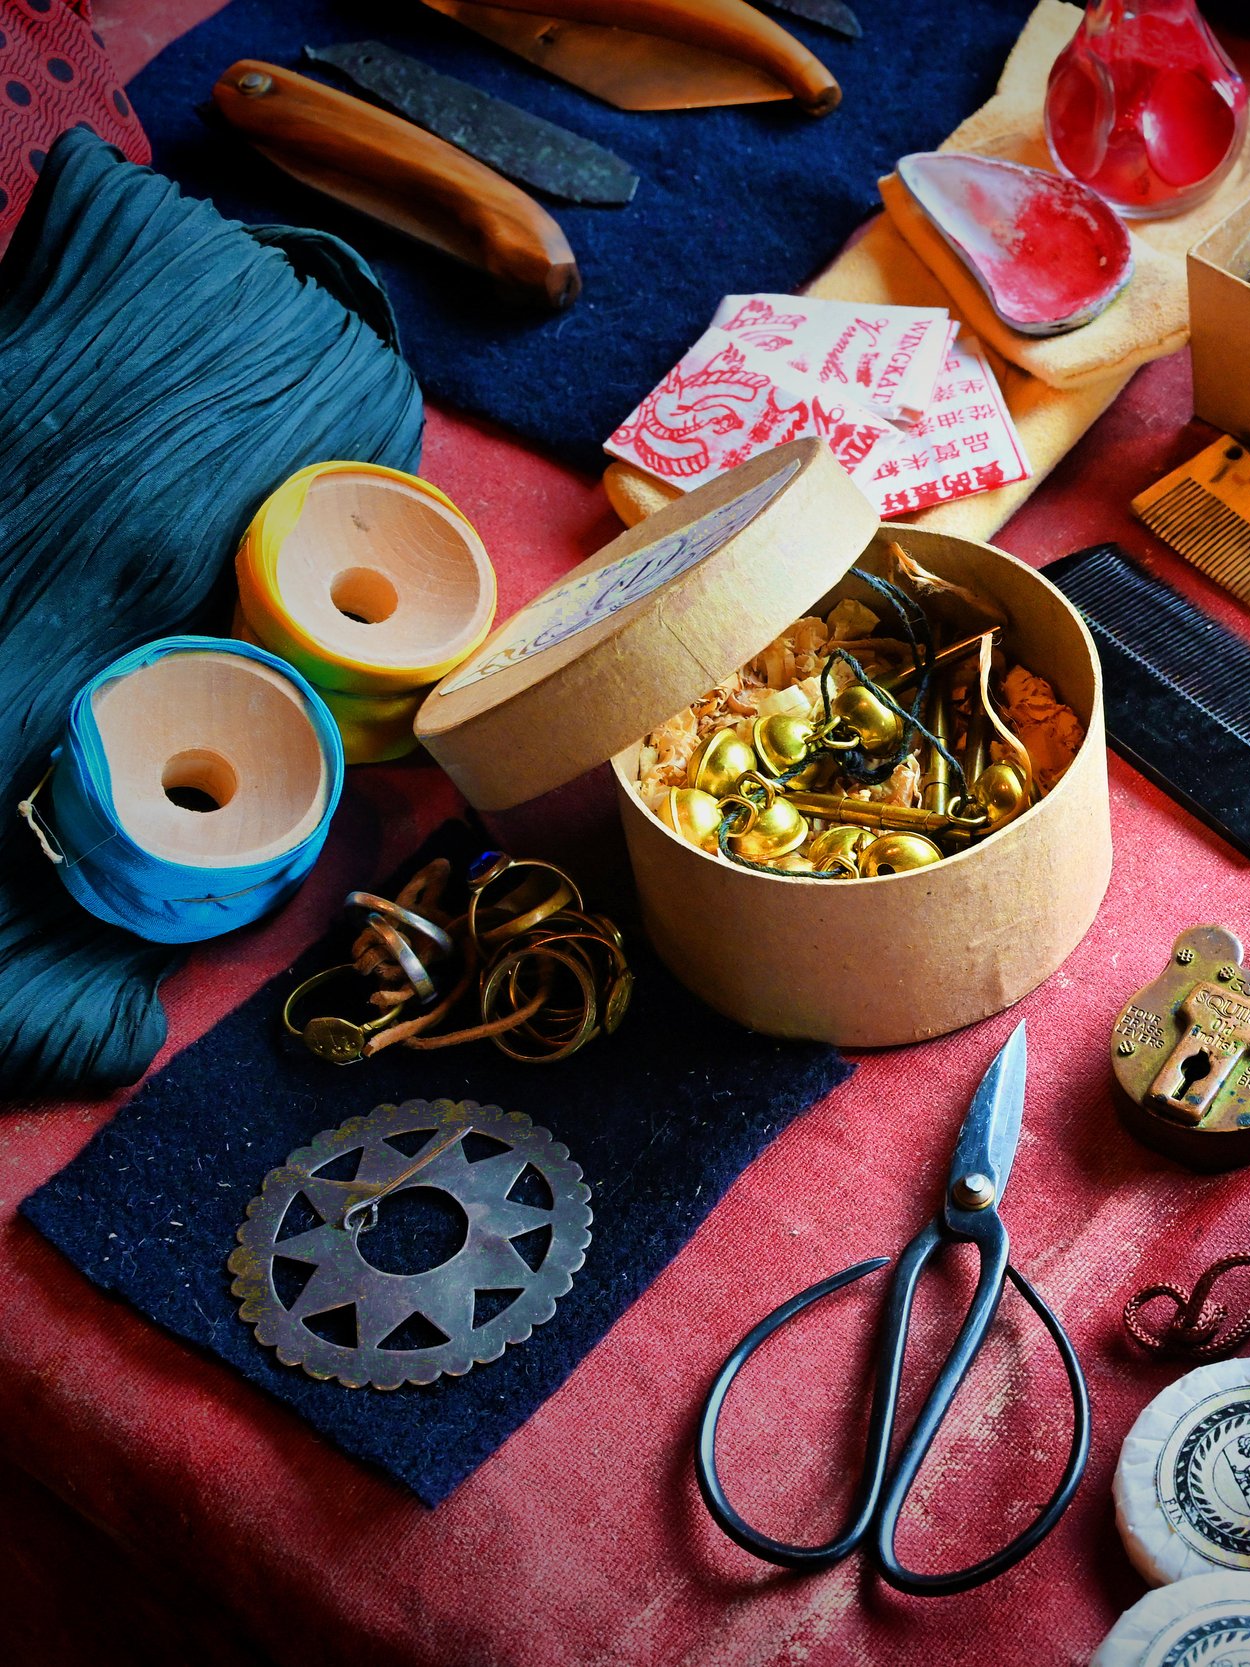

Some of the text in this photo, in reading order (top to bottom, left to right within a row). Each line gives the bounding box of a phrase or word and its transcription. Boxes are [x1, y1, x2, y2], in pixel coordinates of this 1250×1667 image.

[873, 319, 933, 404] WINGKAT
[905, 403, 997, 438] 從油漆
[1121, 1014, 1165, 1038] BRASS
[1126, 1005, 1162, 1025] FOUR
[1211, 1017, 1237, 1037] Old
[1114, 1024, 1165, 1050] LEVERS
[1163, 1497, 1187, 1526] FIN
